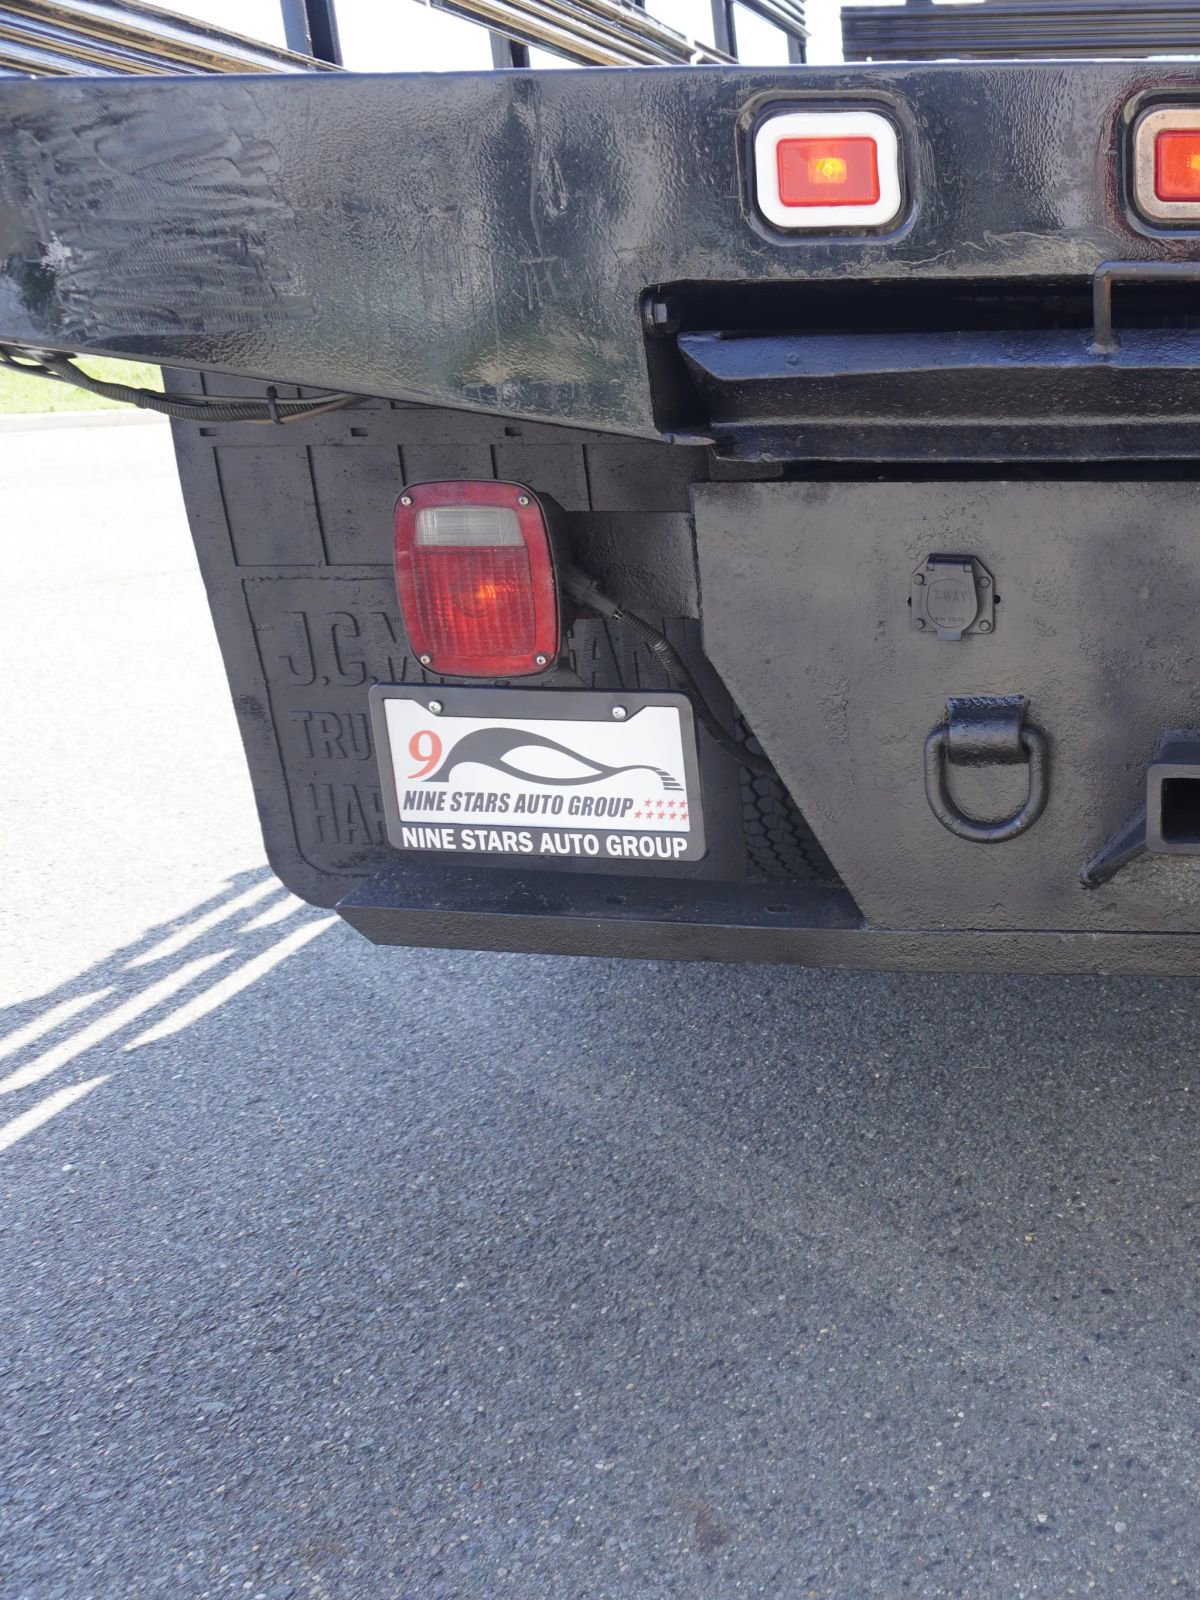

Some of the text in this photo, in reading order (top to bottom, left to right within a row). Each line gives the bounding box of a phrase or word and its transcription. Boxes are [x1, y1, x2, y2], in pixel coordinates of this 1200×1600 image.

[289, 711, 373, 761] TRU
[407, 729, 443, 779] 9
[403, 790, 634, 818] NINE STARS AUTO GROUP
[402, 827, 688, 859] NINE STARS AUTO GROUP
